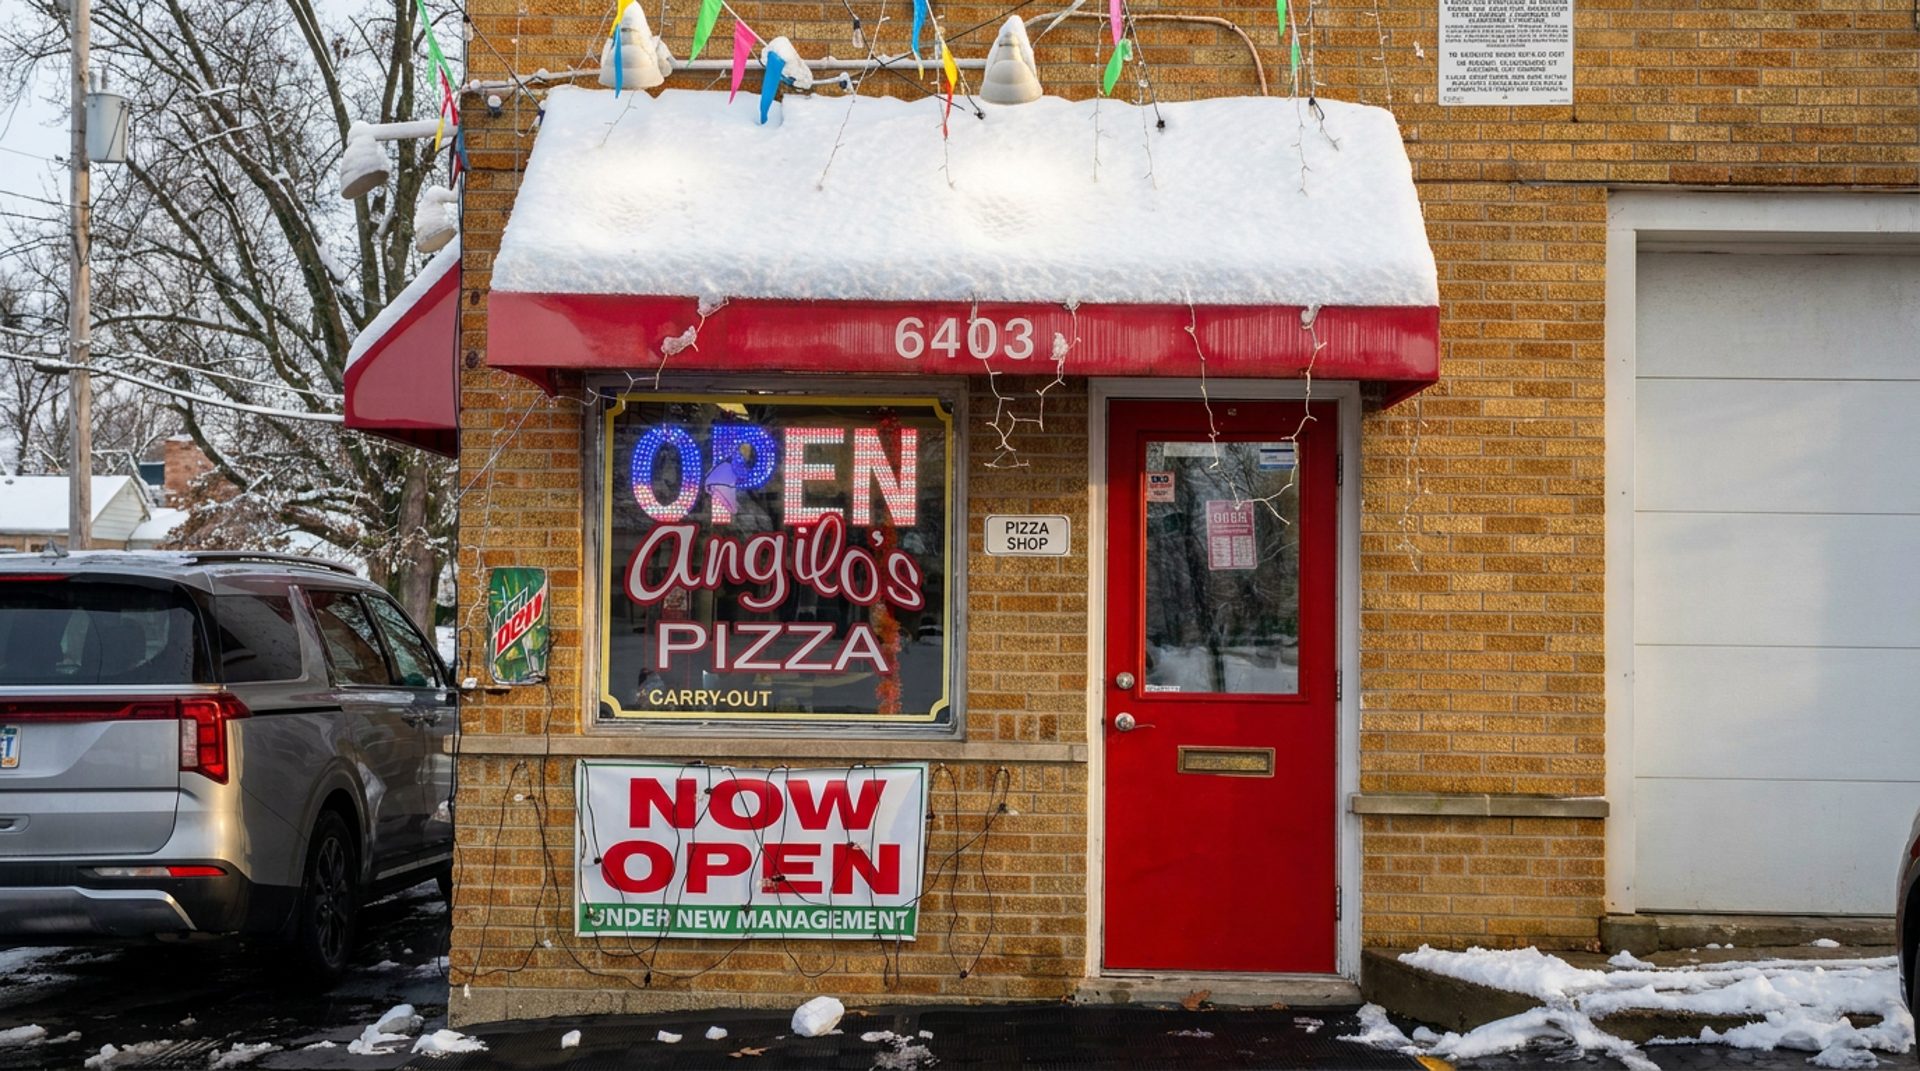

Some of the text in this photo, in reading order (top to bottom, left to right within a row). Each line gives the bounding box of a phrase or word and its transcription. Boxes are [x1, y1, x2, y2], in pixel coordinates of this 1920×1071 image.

[895, 317, 1034, 360] 6403
[632, 423, 917, 526] OPEN
[1005, 521, 1049, 535] PIZZA
[1007, 537, 1048, 550] SHOP
[657, 621, 891, 672] PIZZA
[650, 689, 772, 707] CARRY-OUT
[629, 778, 888, 830] NOW
[601, 840, 900, 895] OPEN
[677, 909, 731, 929] NEW
[736, 909, 909, 931] MANAGEMENT
